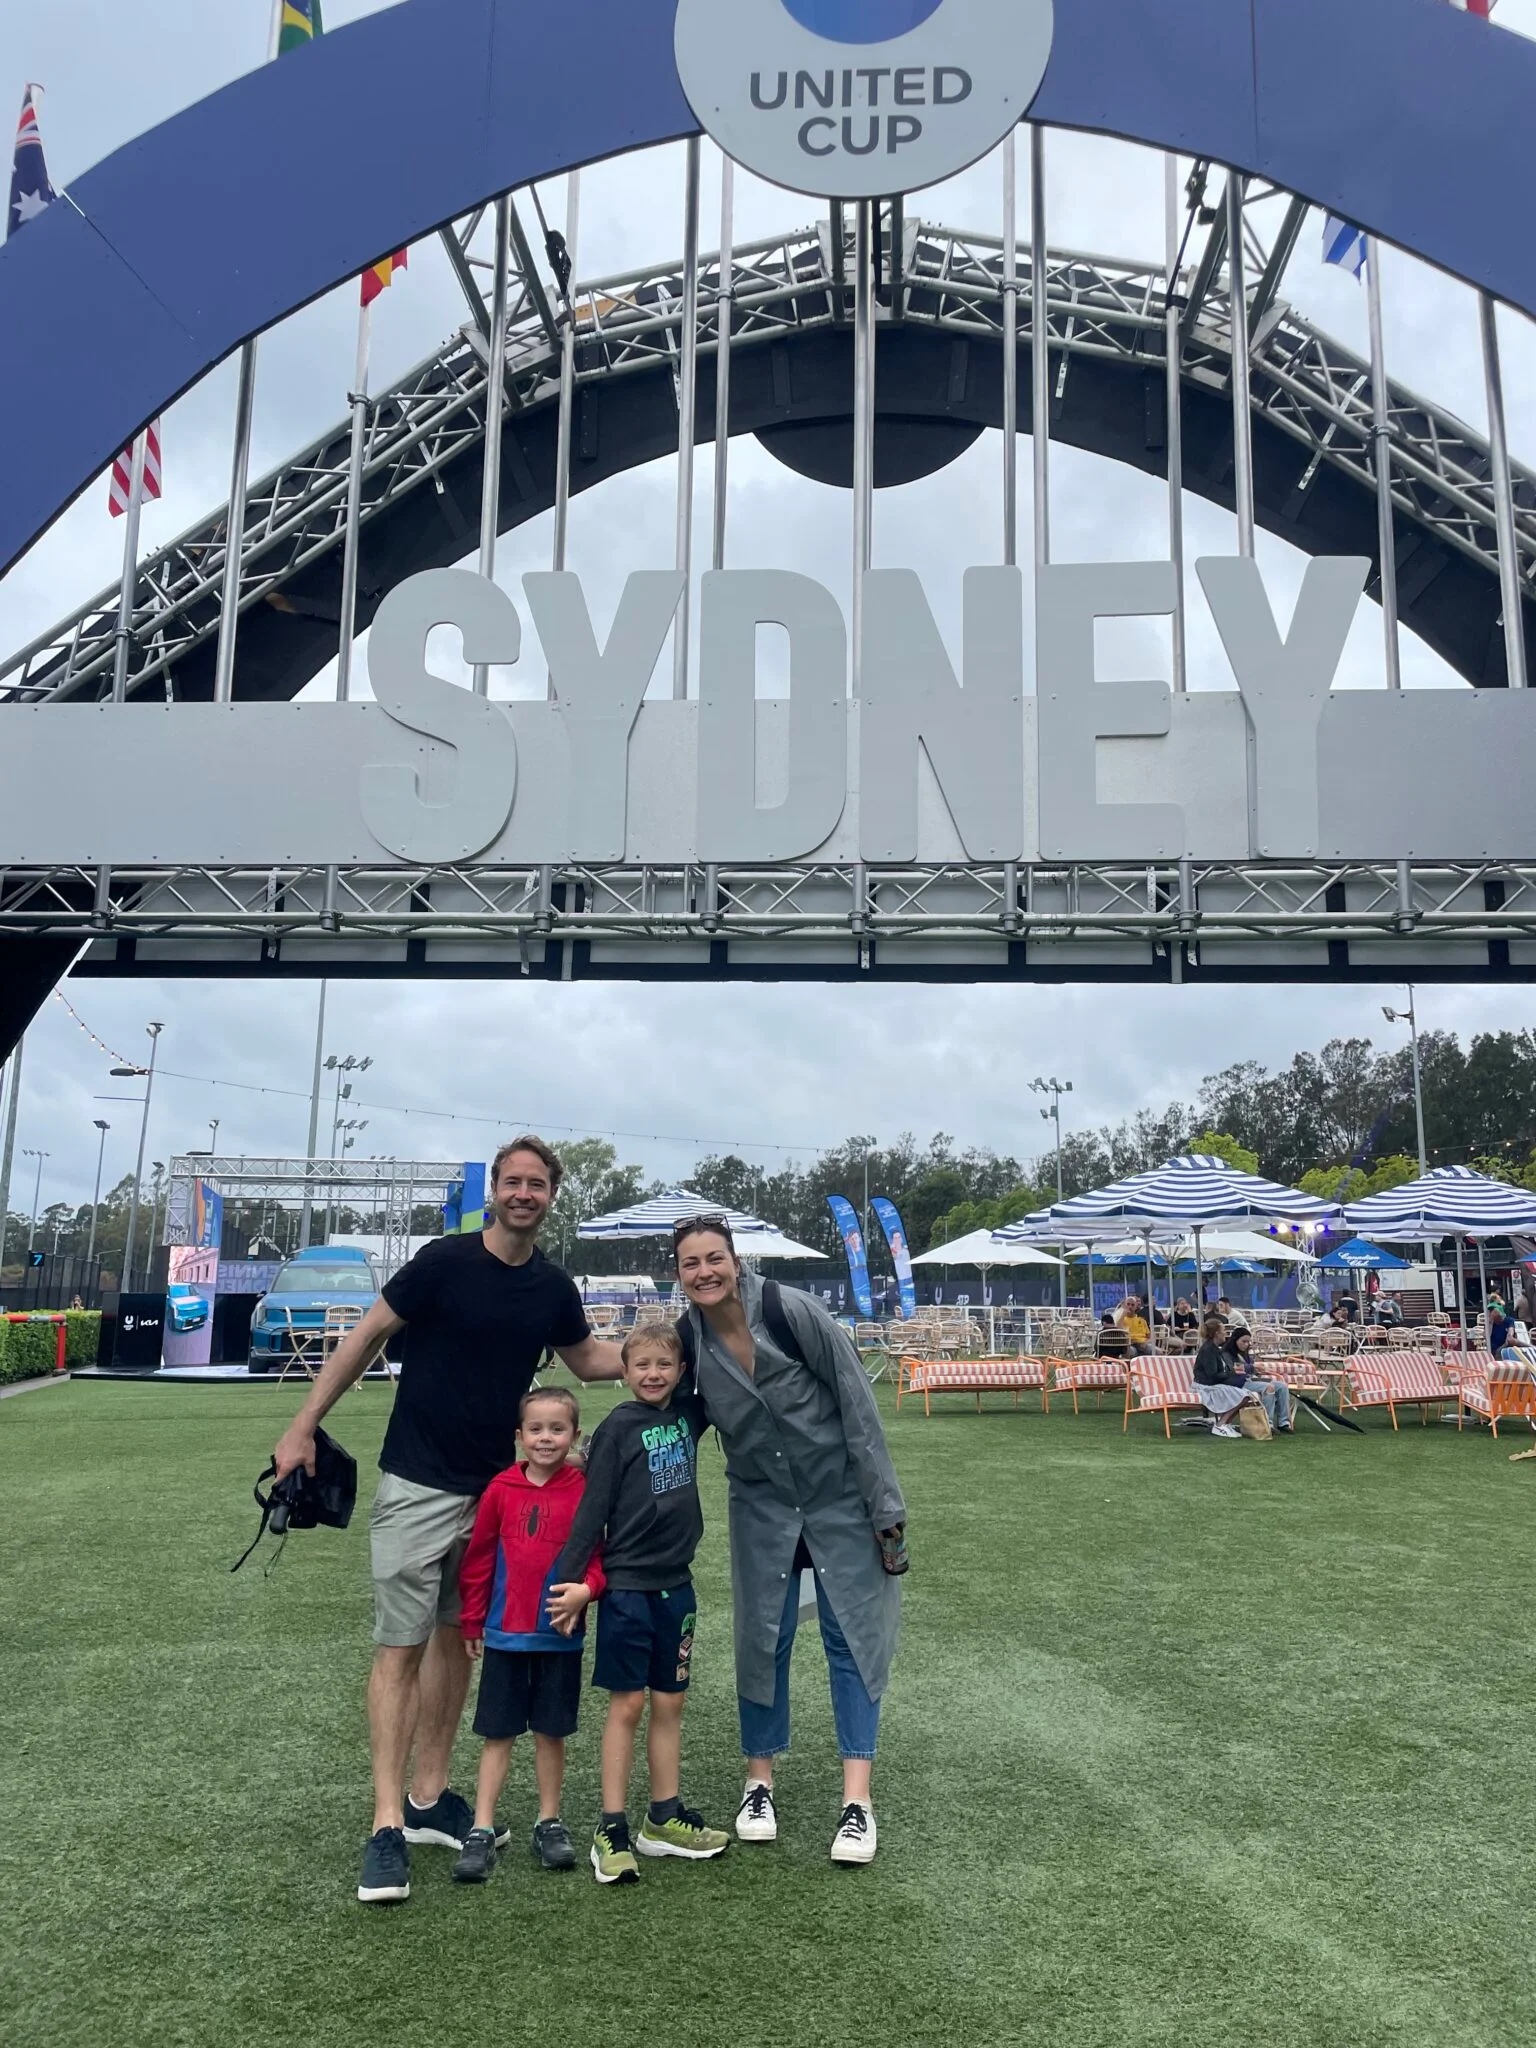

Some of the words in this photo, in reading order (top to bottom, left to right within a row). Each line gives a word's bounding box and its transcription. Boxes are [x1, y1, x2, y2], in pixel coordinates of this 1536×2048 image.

[750, 66, 973, 110] UNITED
[797, 115, 923, 156] CUP
[361, 555, 1373, 865] SYDNEY
[33, 1255, 42, 1265] 7
[641, 1425, 680, 1451] GAME
[648, 1441, 687, 1472] GAME
[651, 1461, 692, 1494] GAME
